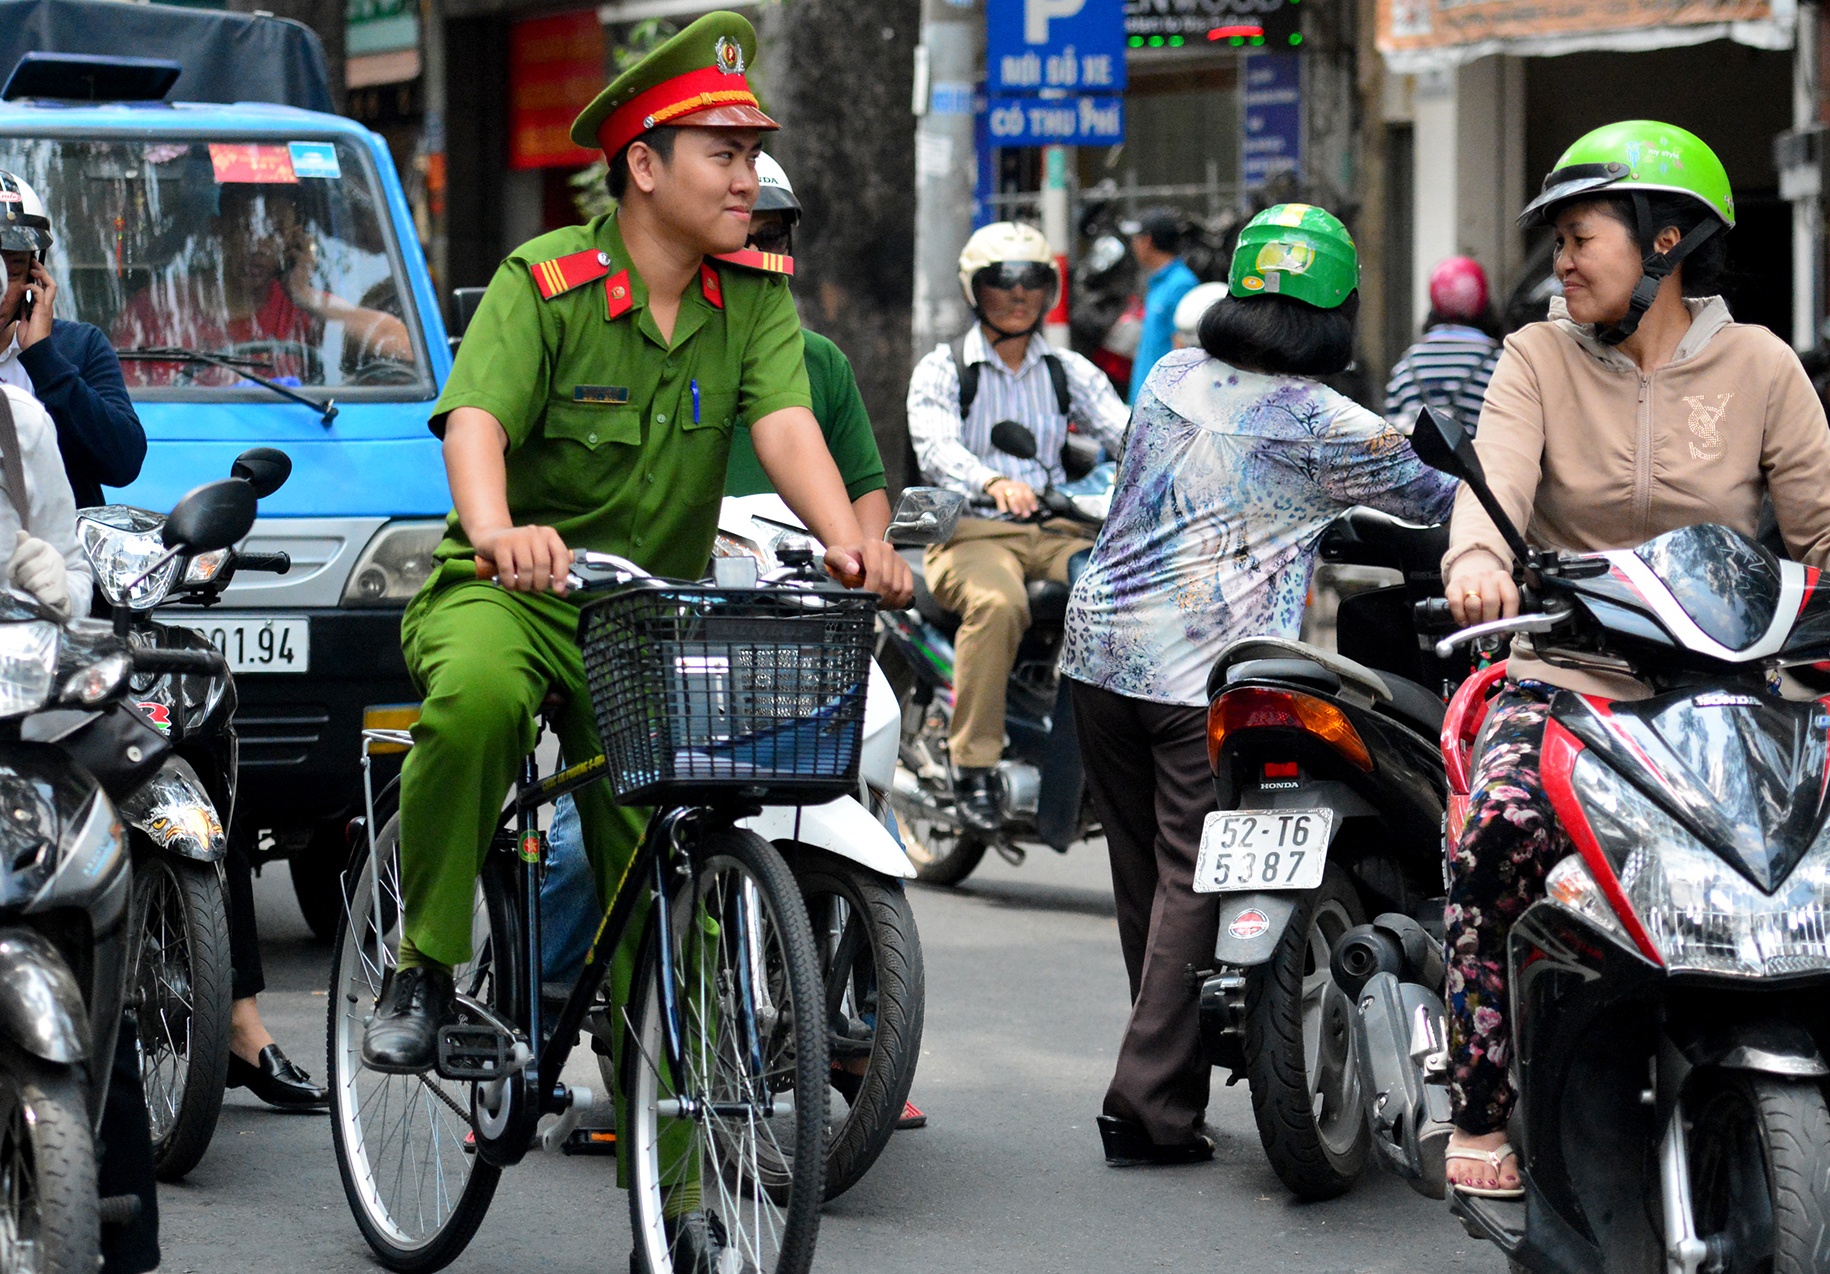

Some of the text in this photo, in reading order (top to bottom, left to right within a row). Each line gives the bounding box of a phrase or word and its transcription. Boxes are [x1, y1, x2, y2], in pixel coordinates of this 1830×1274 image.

[1023, 0, 1087, 45] P
[1082, 54, 1113, 86] XE
[990, 101, 1025, 137] CÓ
[1028, 107, 1076, 137] THU
[1260, 781, 1299, 790] HONDA
[1214, 851, 1306, 885] 5387
